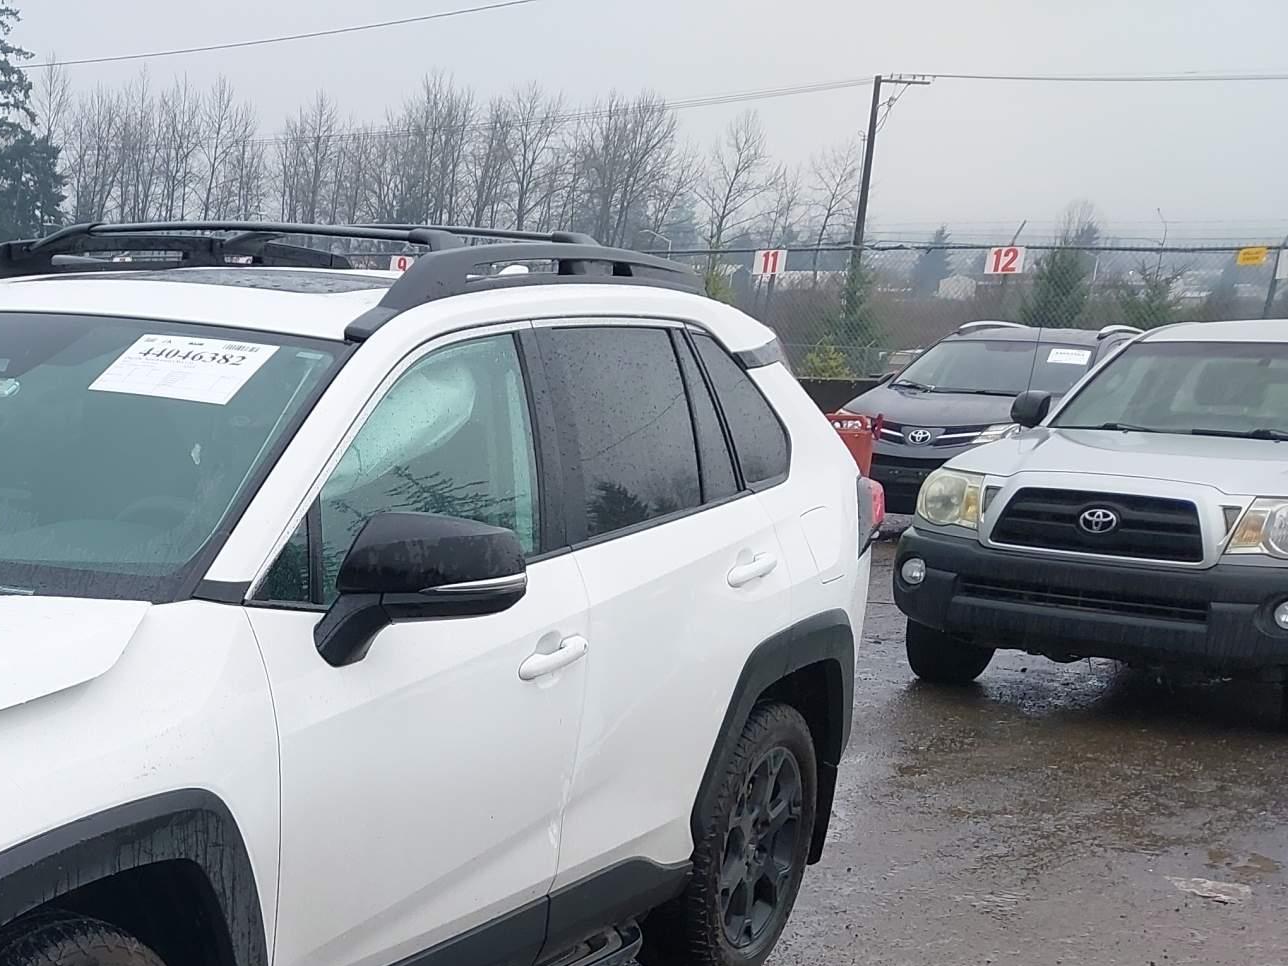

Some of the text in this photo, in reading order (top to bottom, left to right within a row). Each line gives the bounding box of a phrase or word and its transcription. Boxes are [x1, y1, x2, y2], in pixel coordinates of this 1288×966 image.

[762, 251, 778, 273] 11
[992, 247, 1019, 273] 12
[138, 346, 248, 366] 44046382
